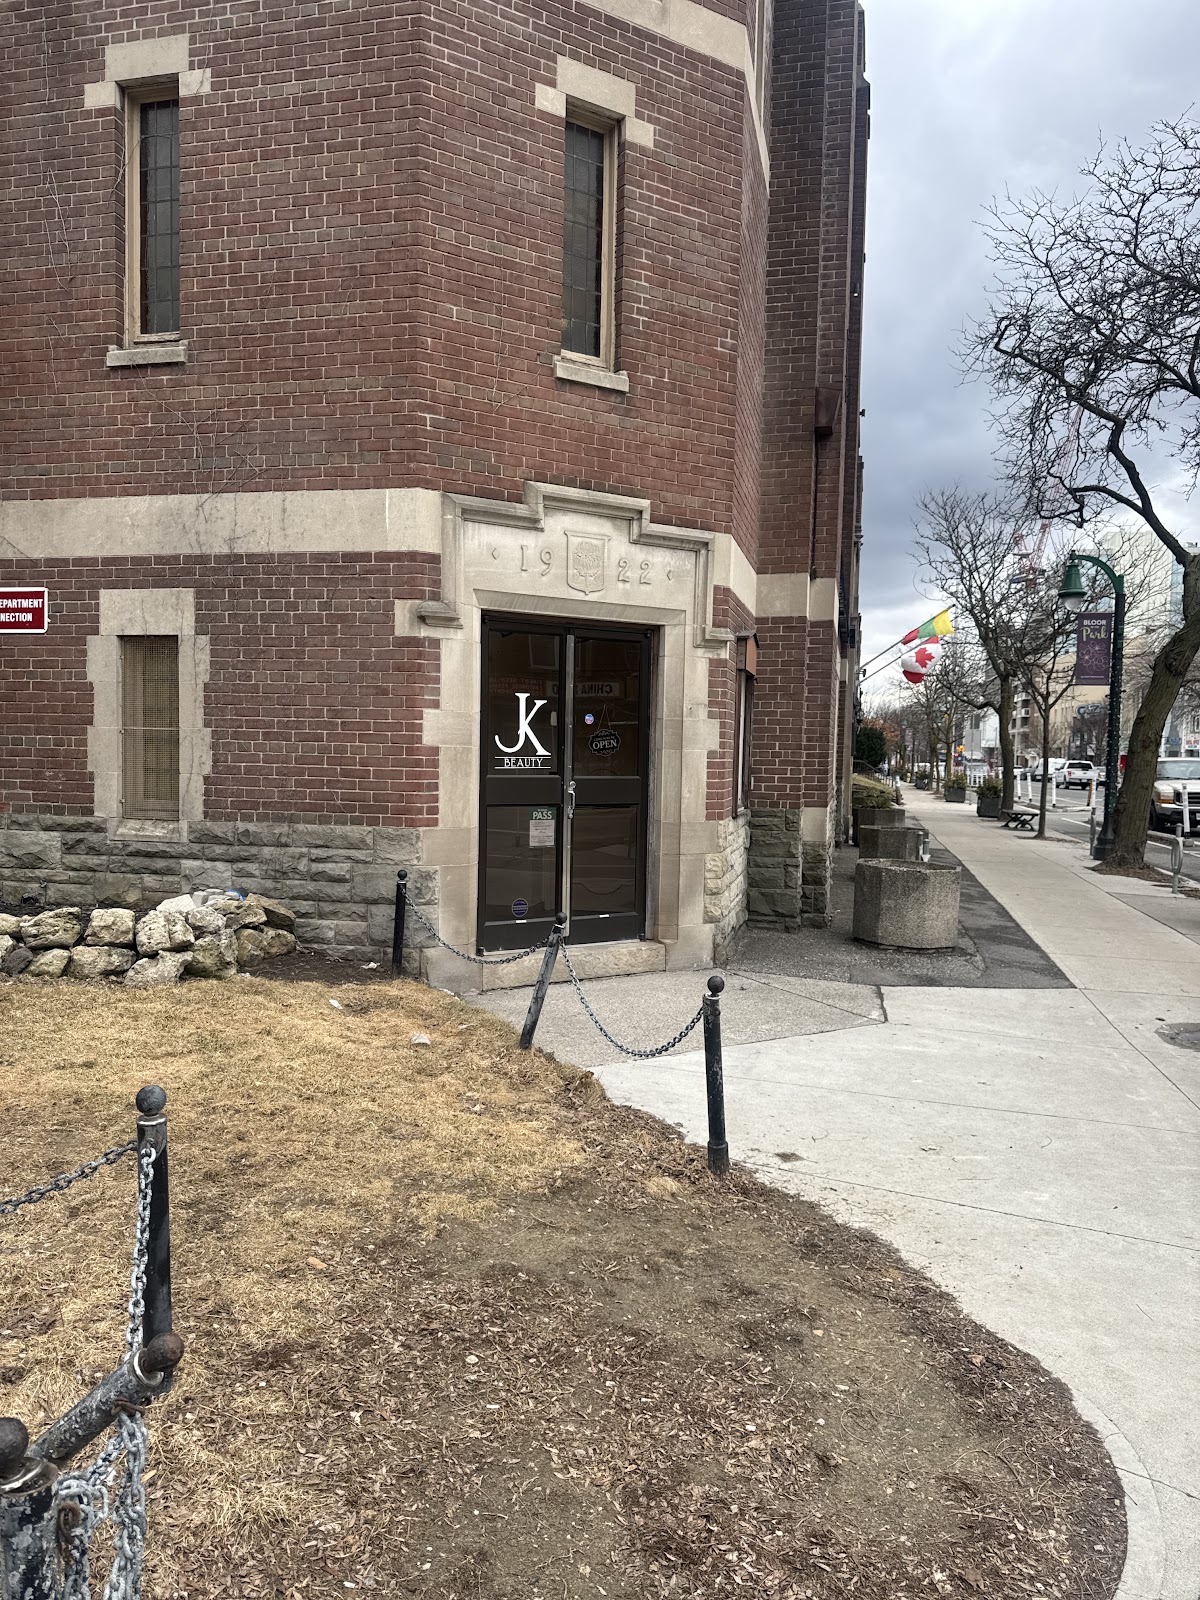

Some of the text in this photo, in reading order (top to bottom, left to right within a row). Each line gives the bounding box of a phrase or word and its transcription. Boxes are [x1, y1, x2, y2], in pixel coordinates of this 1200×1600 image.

[1080, 626, 1108, 641] Park
[494, 692, 551, 755] JK
[592, 739, 617, 750] OPEN
[504, 758, 543, 767] BEAUTY
[532, 811, 552, 820] PASS
